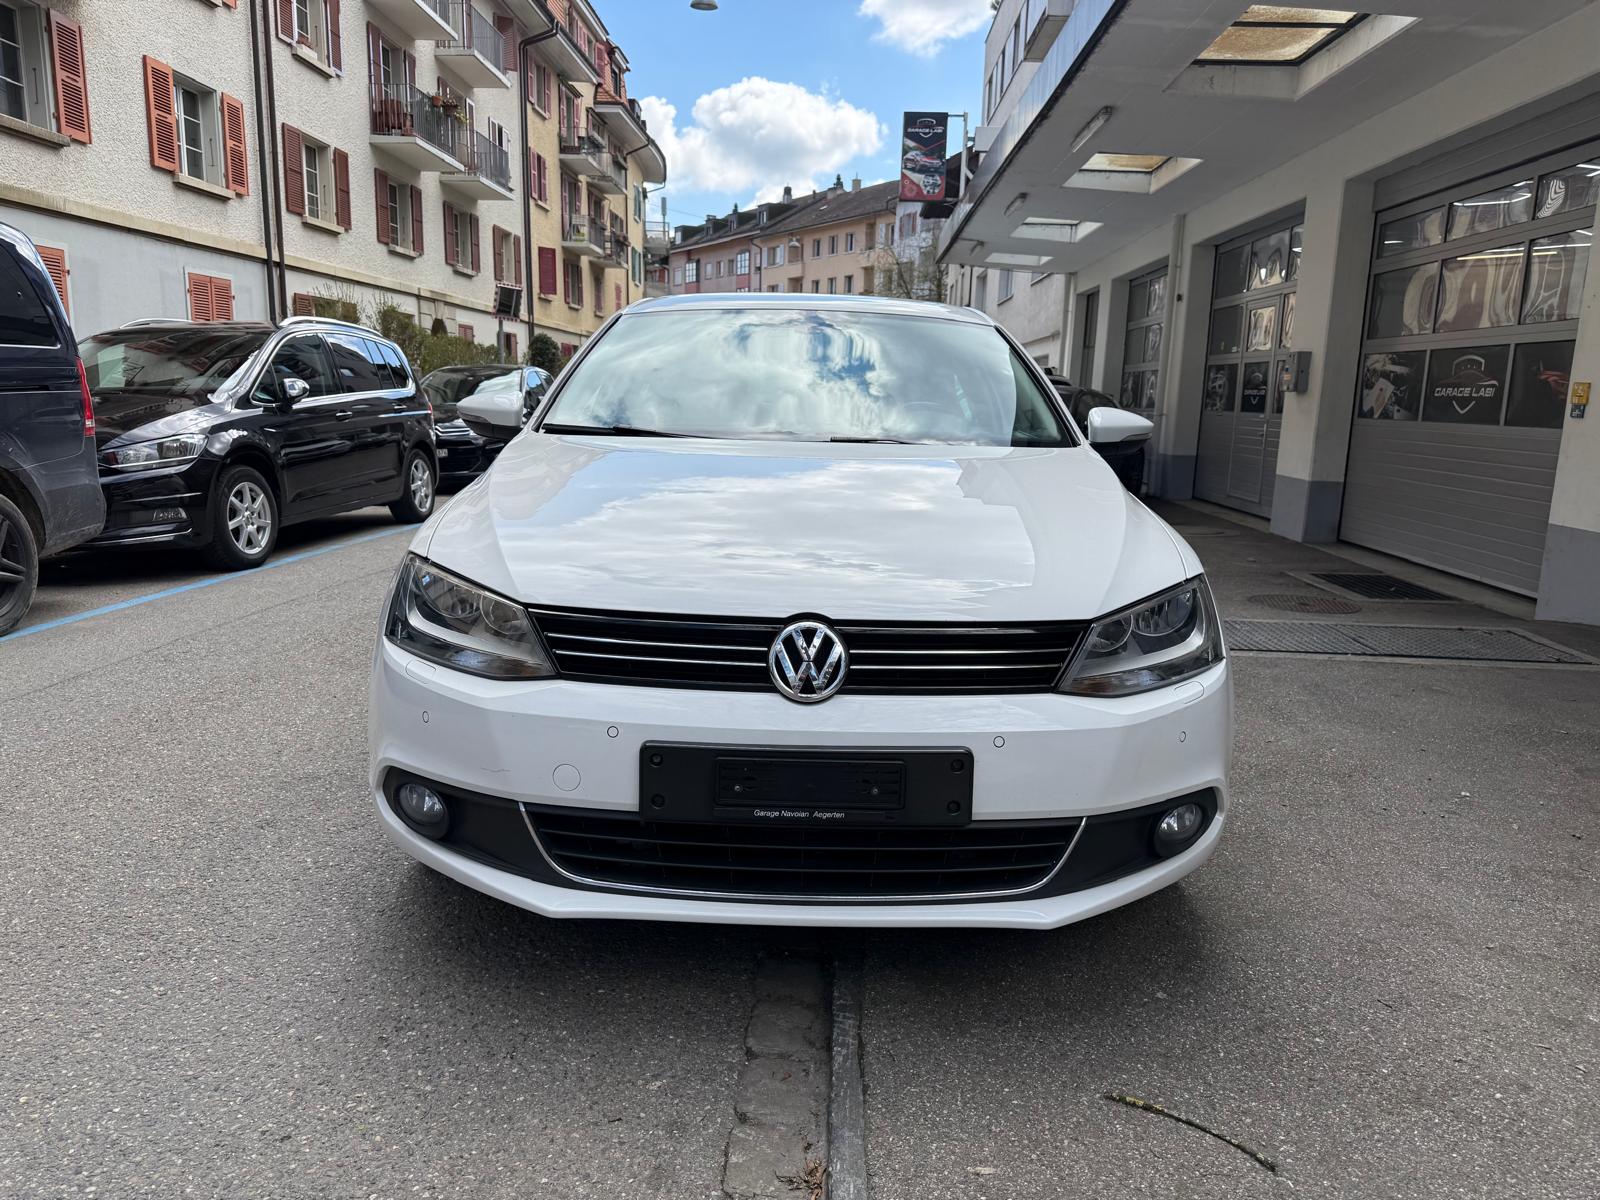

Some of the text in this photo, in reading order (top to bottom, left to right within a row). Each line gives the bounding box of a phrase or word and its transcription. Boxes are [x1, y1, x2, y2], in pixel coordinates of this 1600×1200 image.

[1434, 387, 1472, 397] GARAGE
[772, 624, 845, 699] VW
[753, 809, 780, 818] Garage
[813, 810, 845, 819] Aegerten
